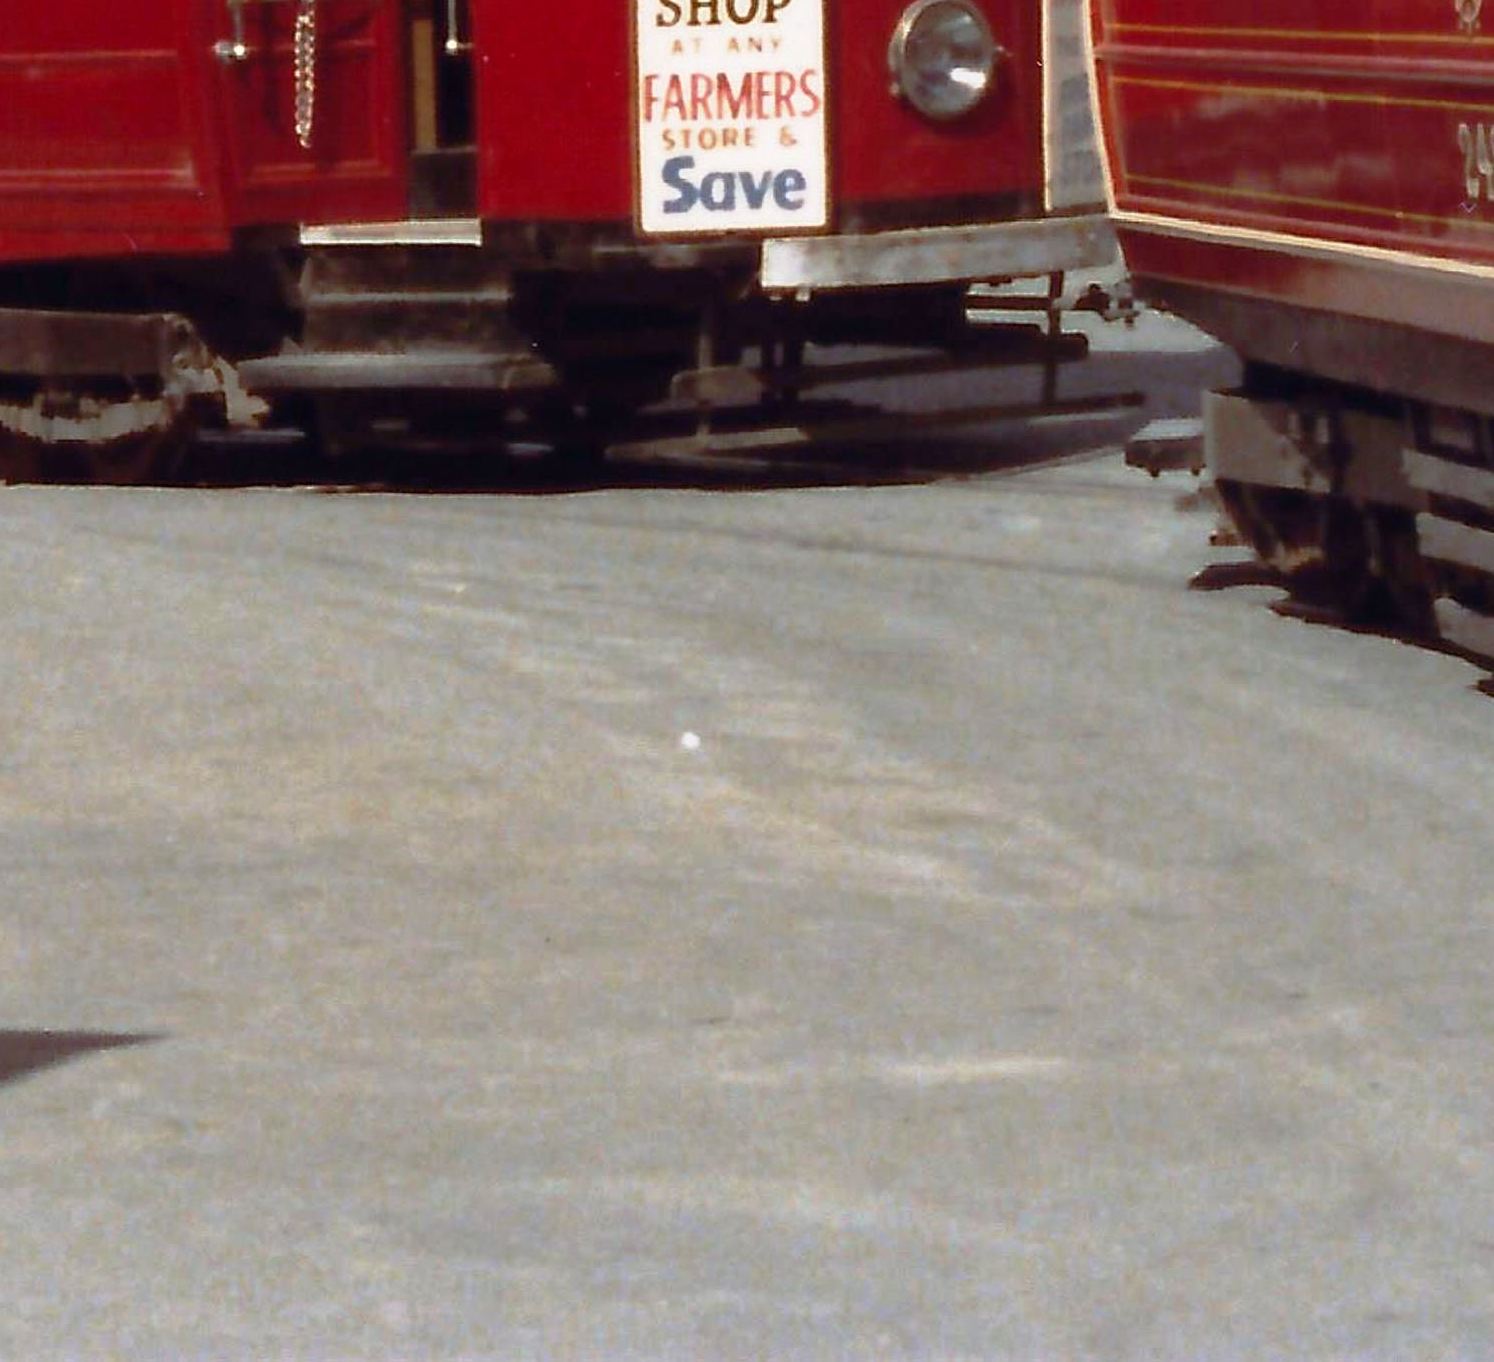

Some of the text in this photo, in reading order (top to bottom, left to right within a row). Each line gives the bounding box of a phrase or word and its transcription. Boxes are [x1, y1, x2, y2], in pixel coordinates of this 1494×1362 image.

[671, 36, 782, 55] AT ANY
[643, 68, 821, 124] FARMERS
[661, 125, 798, 151] STORE &
[661, 155, 807, 214] Save
